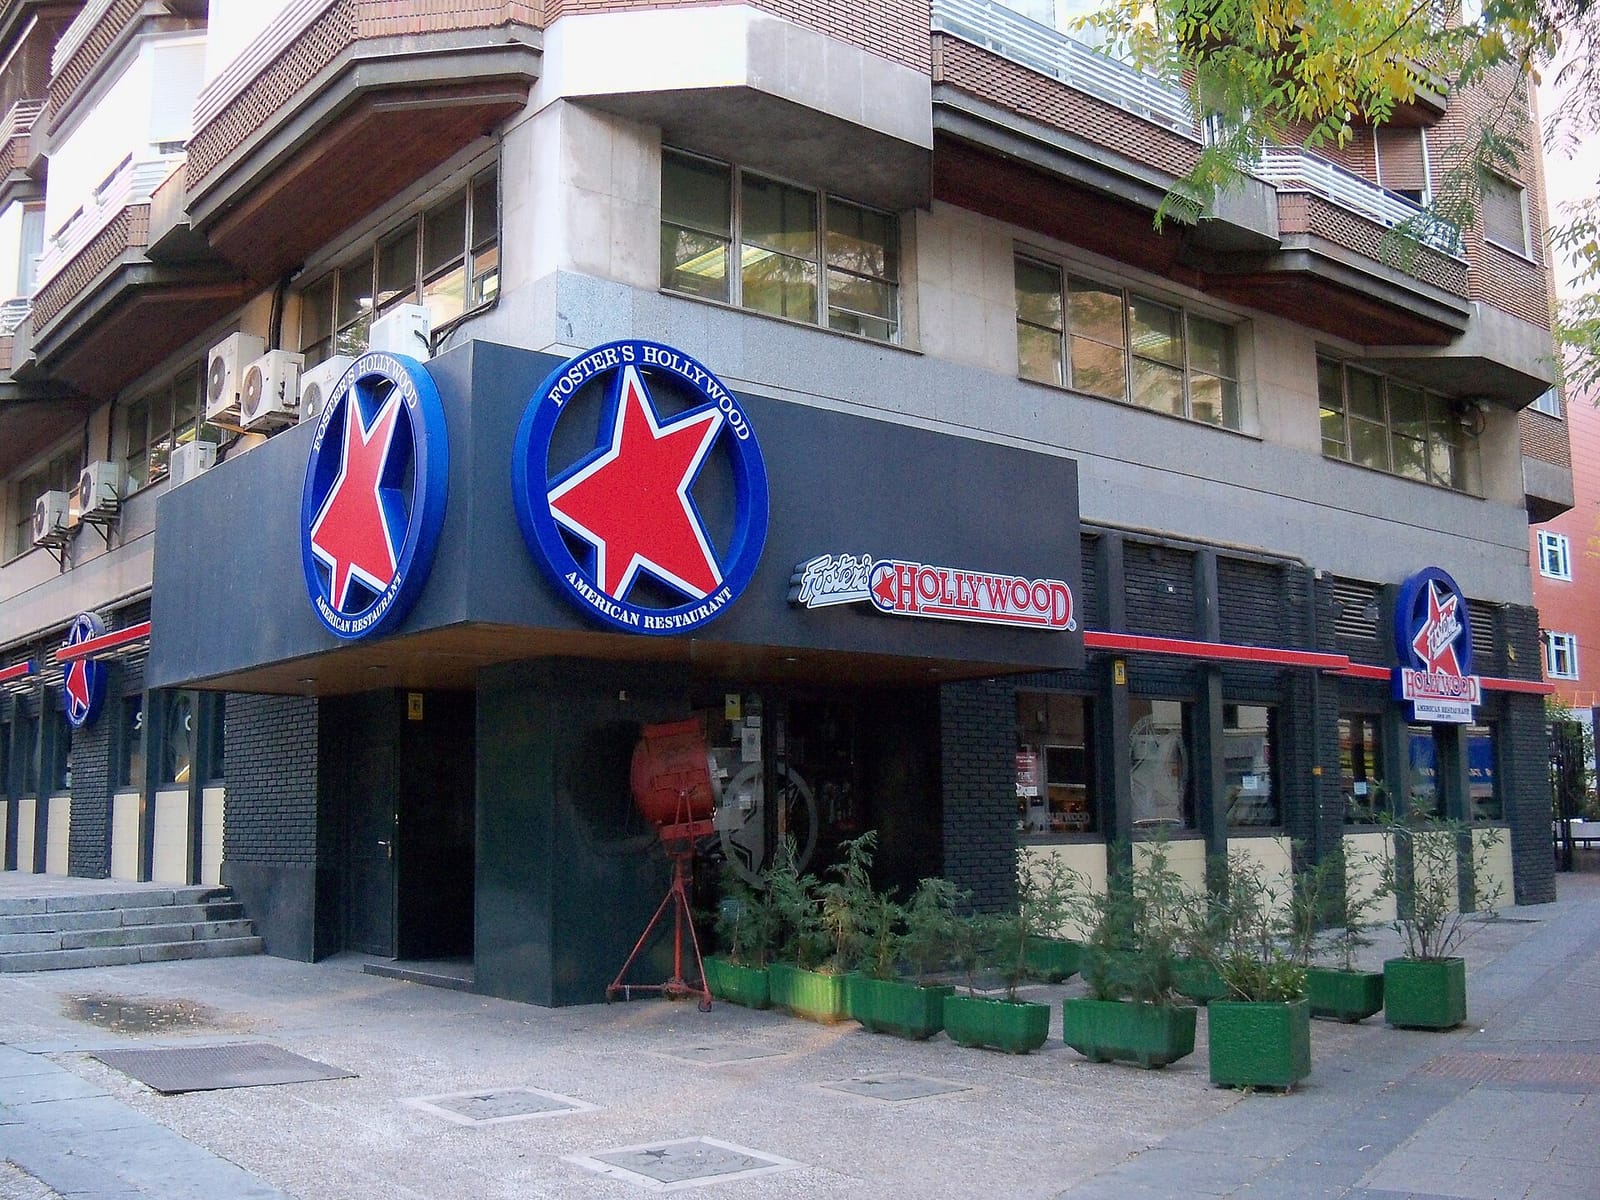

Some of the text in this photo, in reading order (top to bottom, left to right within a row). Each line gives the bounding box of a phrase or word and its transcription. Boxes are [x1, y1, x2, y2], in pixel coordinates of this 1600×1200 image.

[313, 354, 417, 453] FOSTER'S HOLLYWOOD
[549, 345, 749, 440] FOSTER'S HOLLYWOOD
[316, 572, 402, 632] AMERICAN RESTAURANT
[565, 571, 732, 629] AMERICAN RESTAURANT
[799, 554, 1072, 627] Foster's HOLLYWOOD
[1405, 671, 1477, 701] HOLLYWOOD
